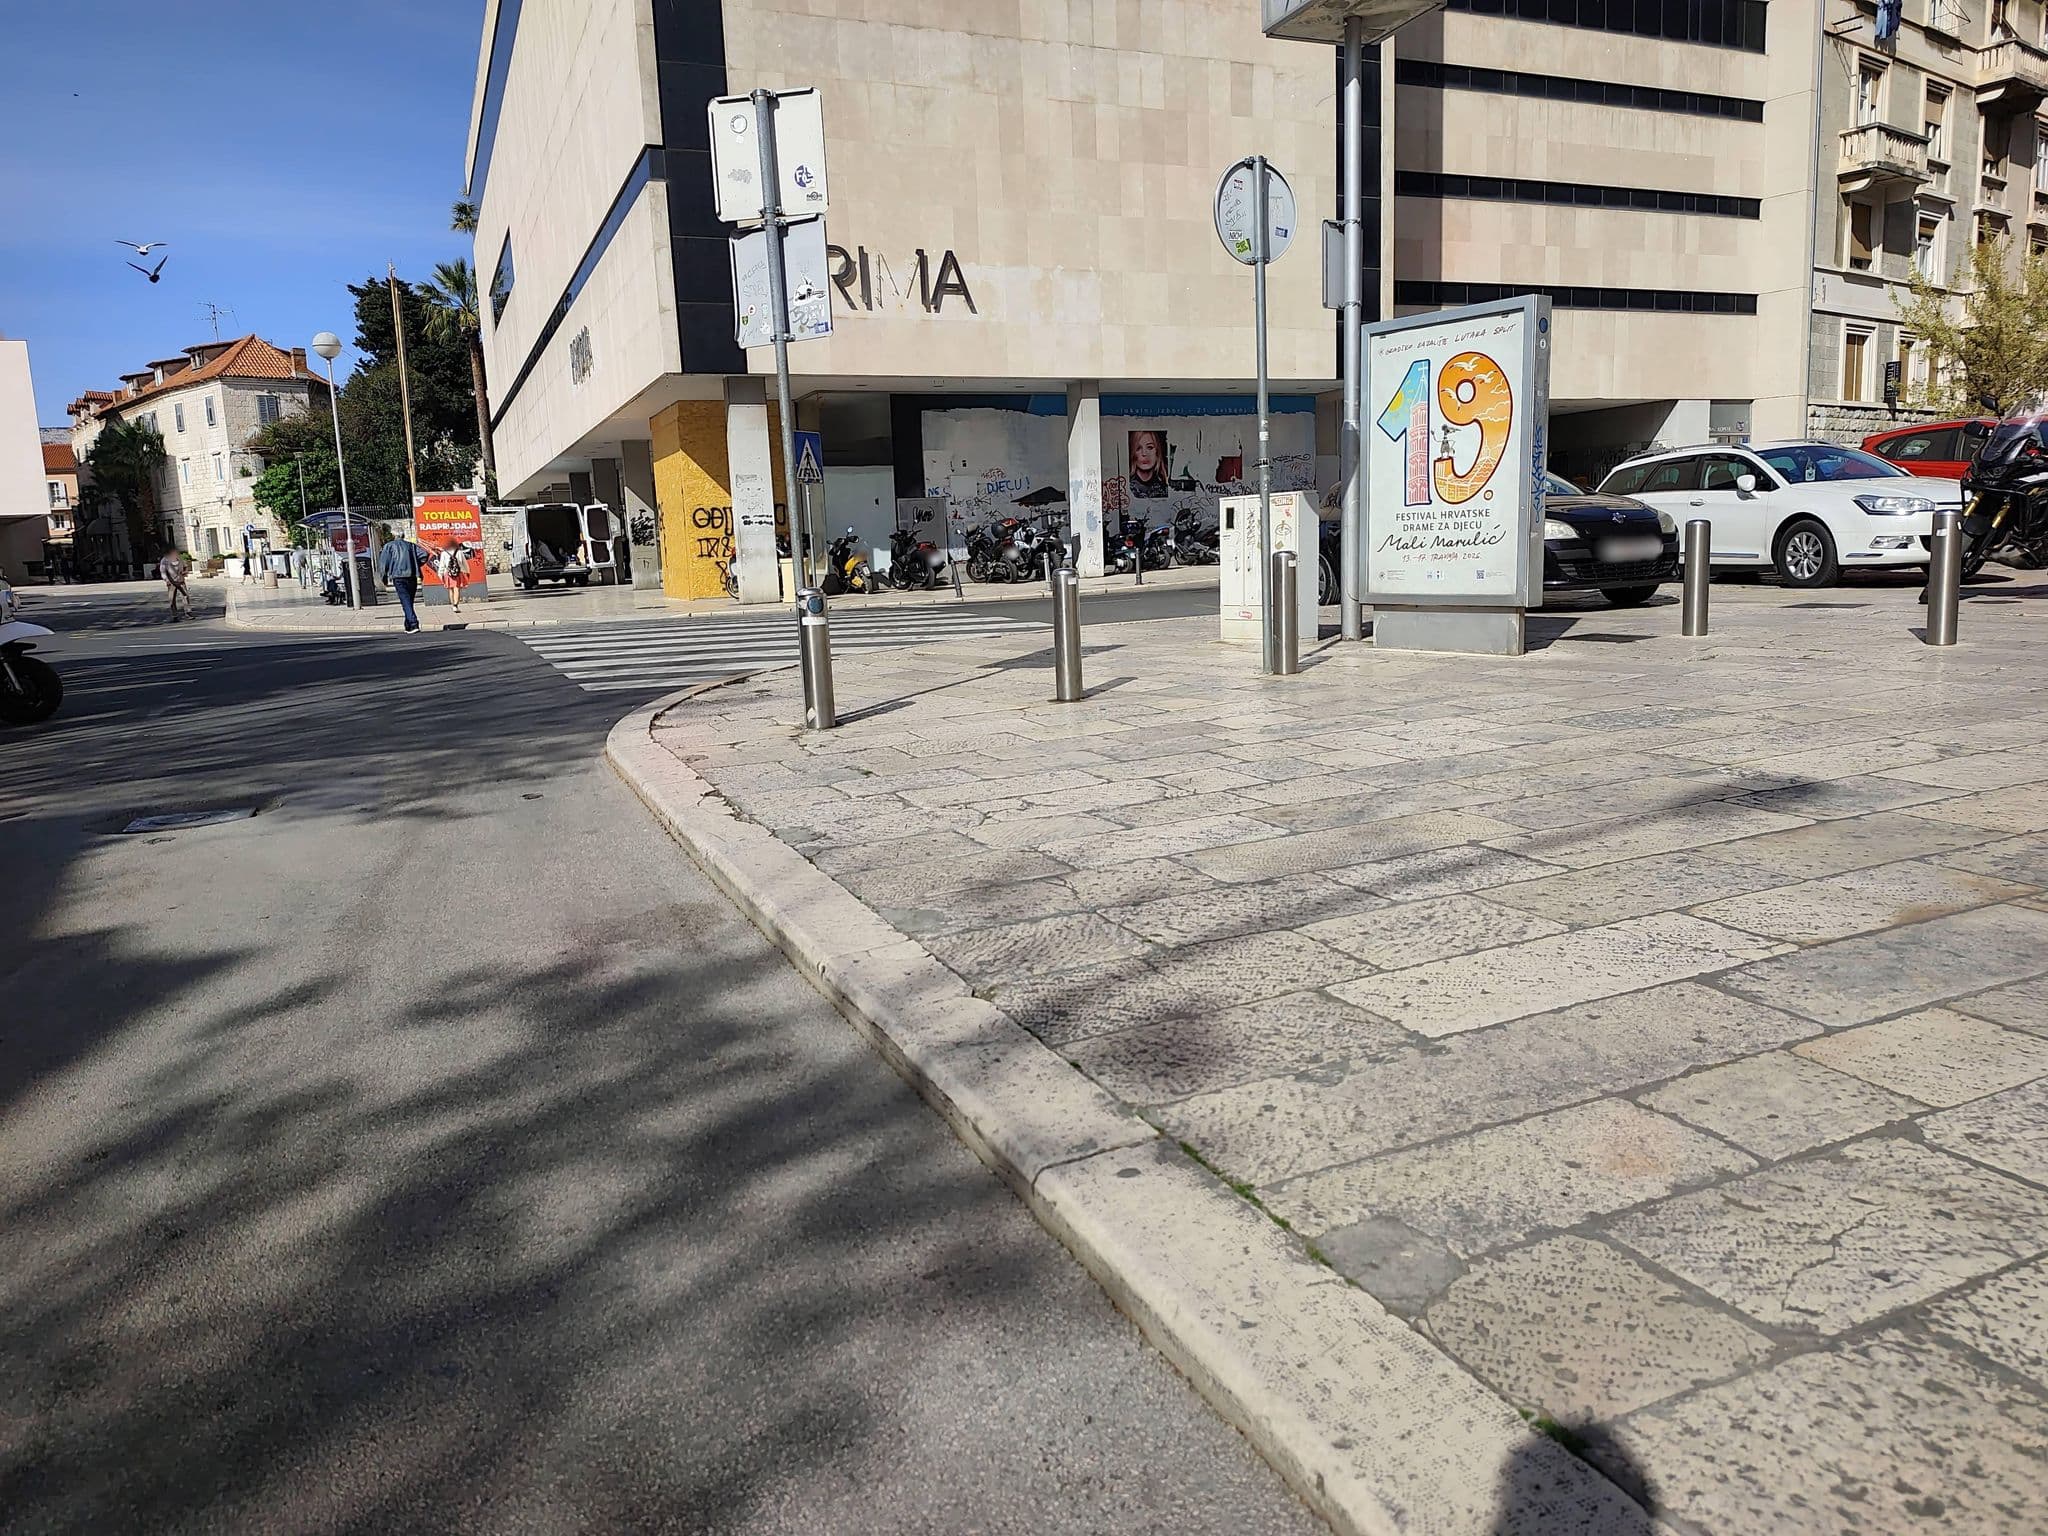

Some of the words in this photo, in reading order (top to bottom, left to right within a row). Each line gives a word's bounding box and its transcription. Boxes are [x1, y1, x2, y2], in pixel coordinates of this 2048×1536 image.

[1454, 328, 1487, 343] LUTAKA
[1493, 323, 1517, 335] SPLIT
[422, 510, 473, 521] TOTALNA
[1395, 511, 1437, 521] FESTIVAL
[1440, 508, 1490, 519] HRVATSKE
[1402, 522, 1434, 532] DRAME
[1438, 522, 1450, 530] ZA
[1453, 520, 1482, 531] DJECU
[1376, 533, 1428, 552] Mali
[1430, 524, 1507, 549] Marulić
